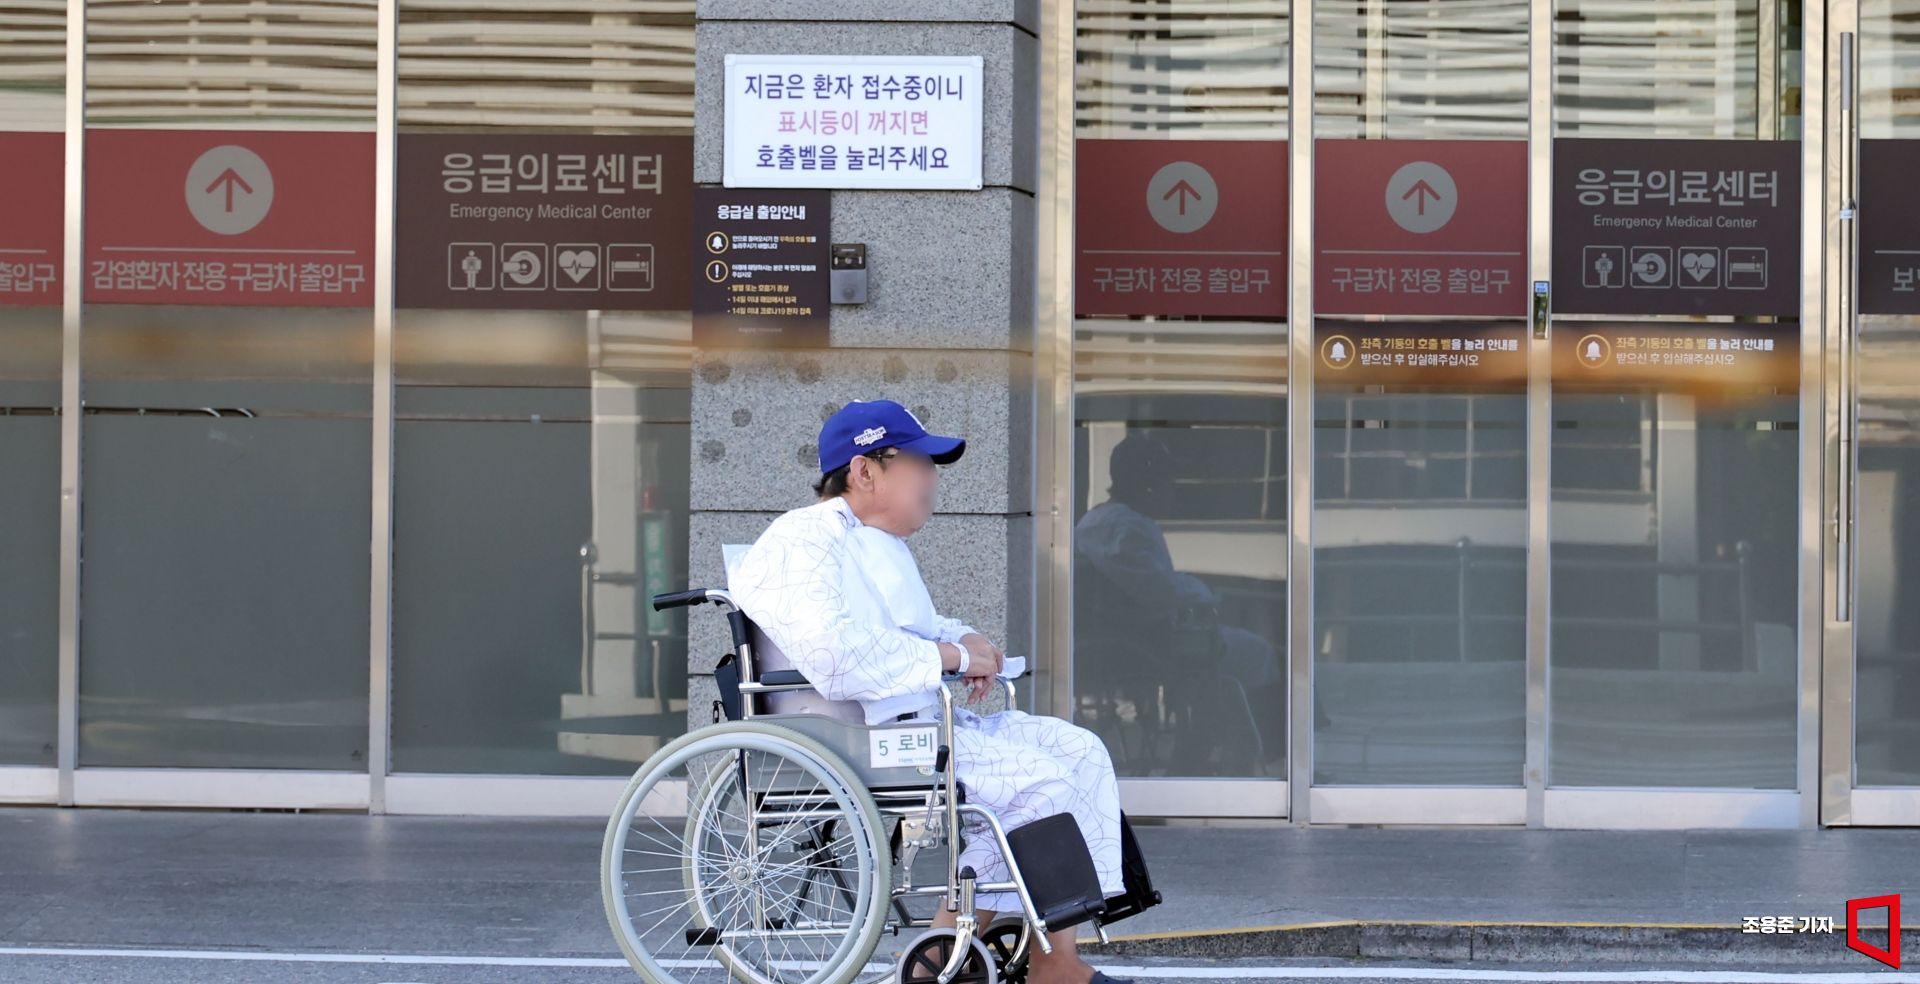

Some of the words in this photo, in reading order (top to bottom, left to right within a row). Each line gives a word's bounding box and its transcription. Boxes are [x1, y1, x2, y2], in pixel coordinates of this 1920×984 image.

[744, 73, 805, 99] 지금은
[813, 73, 854, 100] 환자
[861, 74, 963, 100] 접수중이니
[777, 110, 859, 136] 표시등이
[867, 110, 929, 136] 꺼지면
[756, 144, 838, 170] 호출벨을
[846, 145, 949, 171] 눌러주세요
[441, 153, 662, 194] 응급의료센터
[1575, 168, 1778, 207] 응급의료센터
[450, 203, 533, 221] Emergency
[538, 204, 596, 219] Medical
[601, 204, 653, 220] Center
[717, 205, 754, 220] 응급실
[757, 205, 806, 220] 출입안내
[1593, 214, 1662, 229] Emergency
[1666, 216, 1712, 228] Medical
[1716, 216, 1758, 228] Center
[91, 260, 180, 291] 감염환자
[183, 261, 227, 292] 전용
[230, 262, 297, 293] 구급차
[299, 262, 366, 294] 출입구
[1093, 267, 1156, 293] 구급차
[1161, 268, 1202, 293] 전용
[1208, 267, 1271, 294] 출입구
[1332, 267, 1396, 293] 구급차
[1400, 268, 1442, 294] 전용
[1447, 267, 1511, 294] 출입구
[1892, 267, 1920, 291] 보
[1361, 338, 1381, 349] 좌측
[1384, 338, 1415, 349] 기둥의
[1418, 338, 1438, 349] 호출
[1440, 338, 1461, 350] 벨을
[1464, 339, 1484, 350] 눌러
[1487, 339, 1518, 351] 안내를
[1616, 337, 1637, 349] 좌측
[1639, 338, 1670, 349] 기둥의
[1673, 338, 1694, 349] 호출
[1696, 338, 1717, 350] 벨을
[1720, 339, 1740, 350] 눌러
[1743, 339, 1774, 351] 안내를
[1361, 353, 1391, 365] 받으신
[1395, 353, 1405, 365] 후
[1408, 353, 1479, 366] 입실해주십시오
[1616, 353, 1647, 365] 받으신
[1650, 353, 1660, 365] 후
[1663, 353, 1735, 366] 입실해주십시오
[879, 740, 888, 756] 5
[898, 732, 933, 753] 로비
